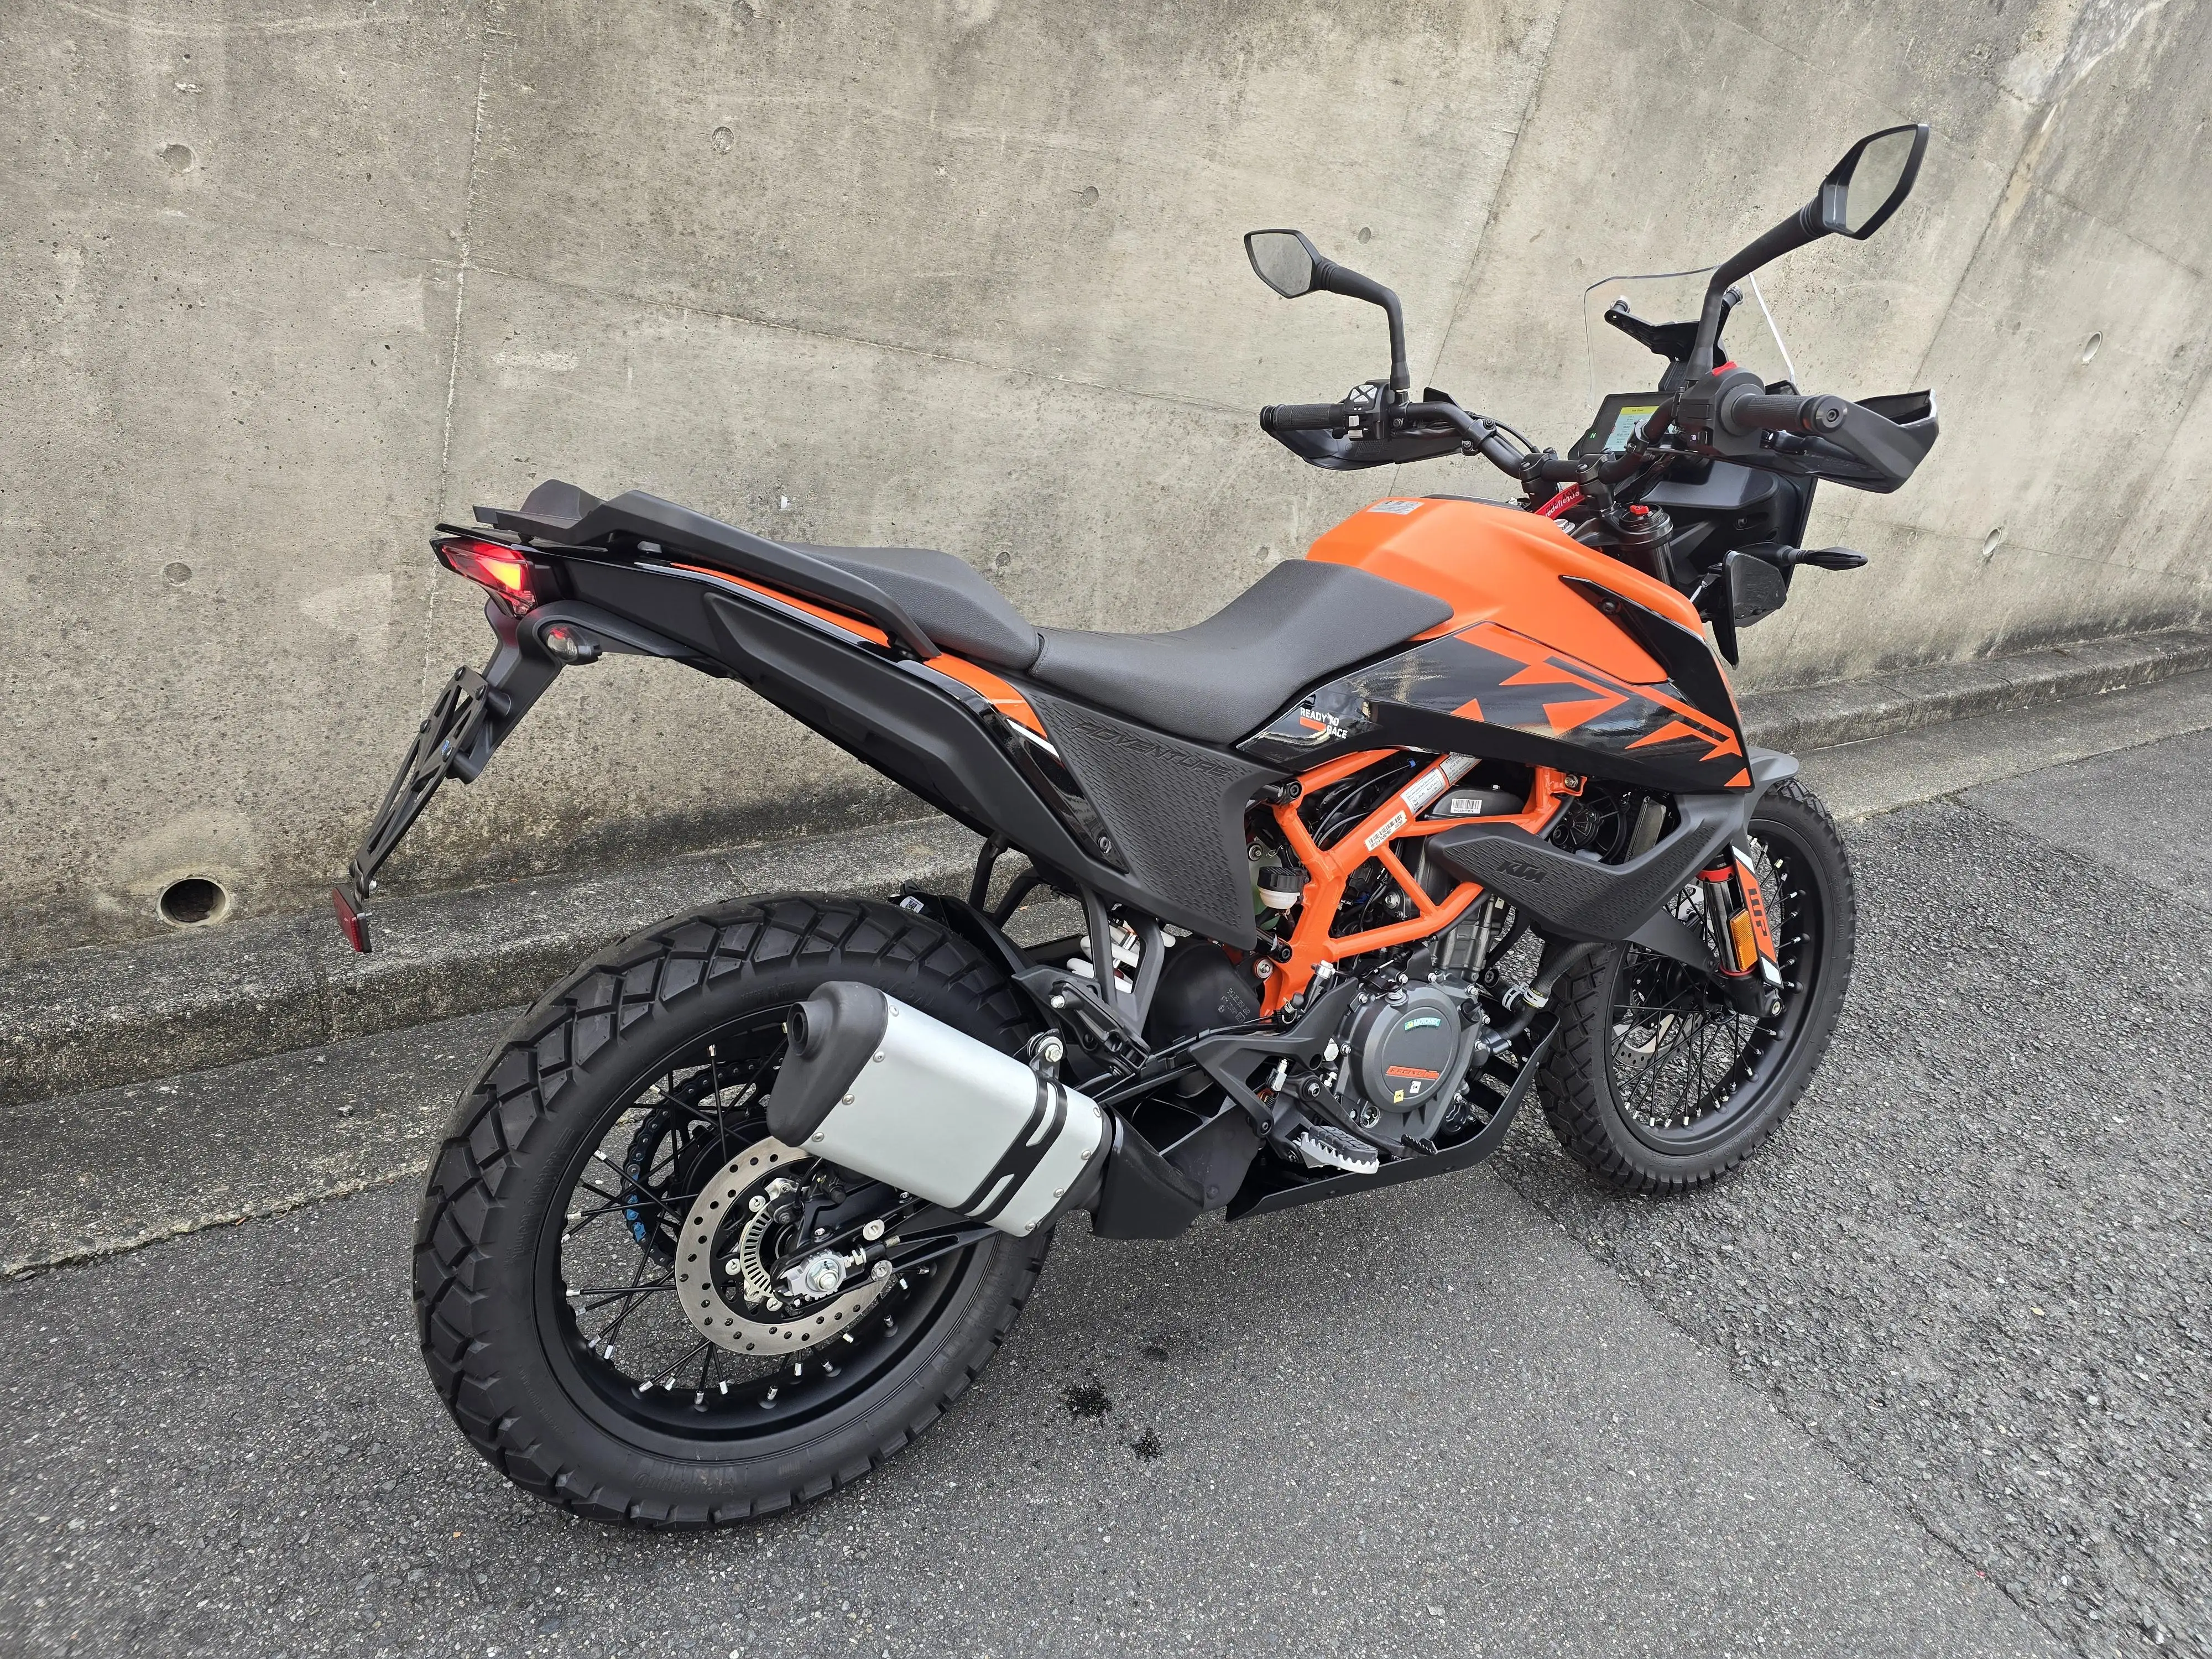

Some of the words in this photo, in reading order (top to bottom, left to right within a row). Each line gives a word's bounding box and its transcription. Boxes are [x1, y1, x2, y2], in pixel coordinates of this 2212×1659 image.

[1300, 707, 1327, 723] READY
[1327, 713, 1339, 726] TO
[1327, 725, 1348, 739] RACE
[1071, 722, 1232, 779] ADVENTURE
[1495, 862, 1547, 884] KTM
